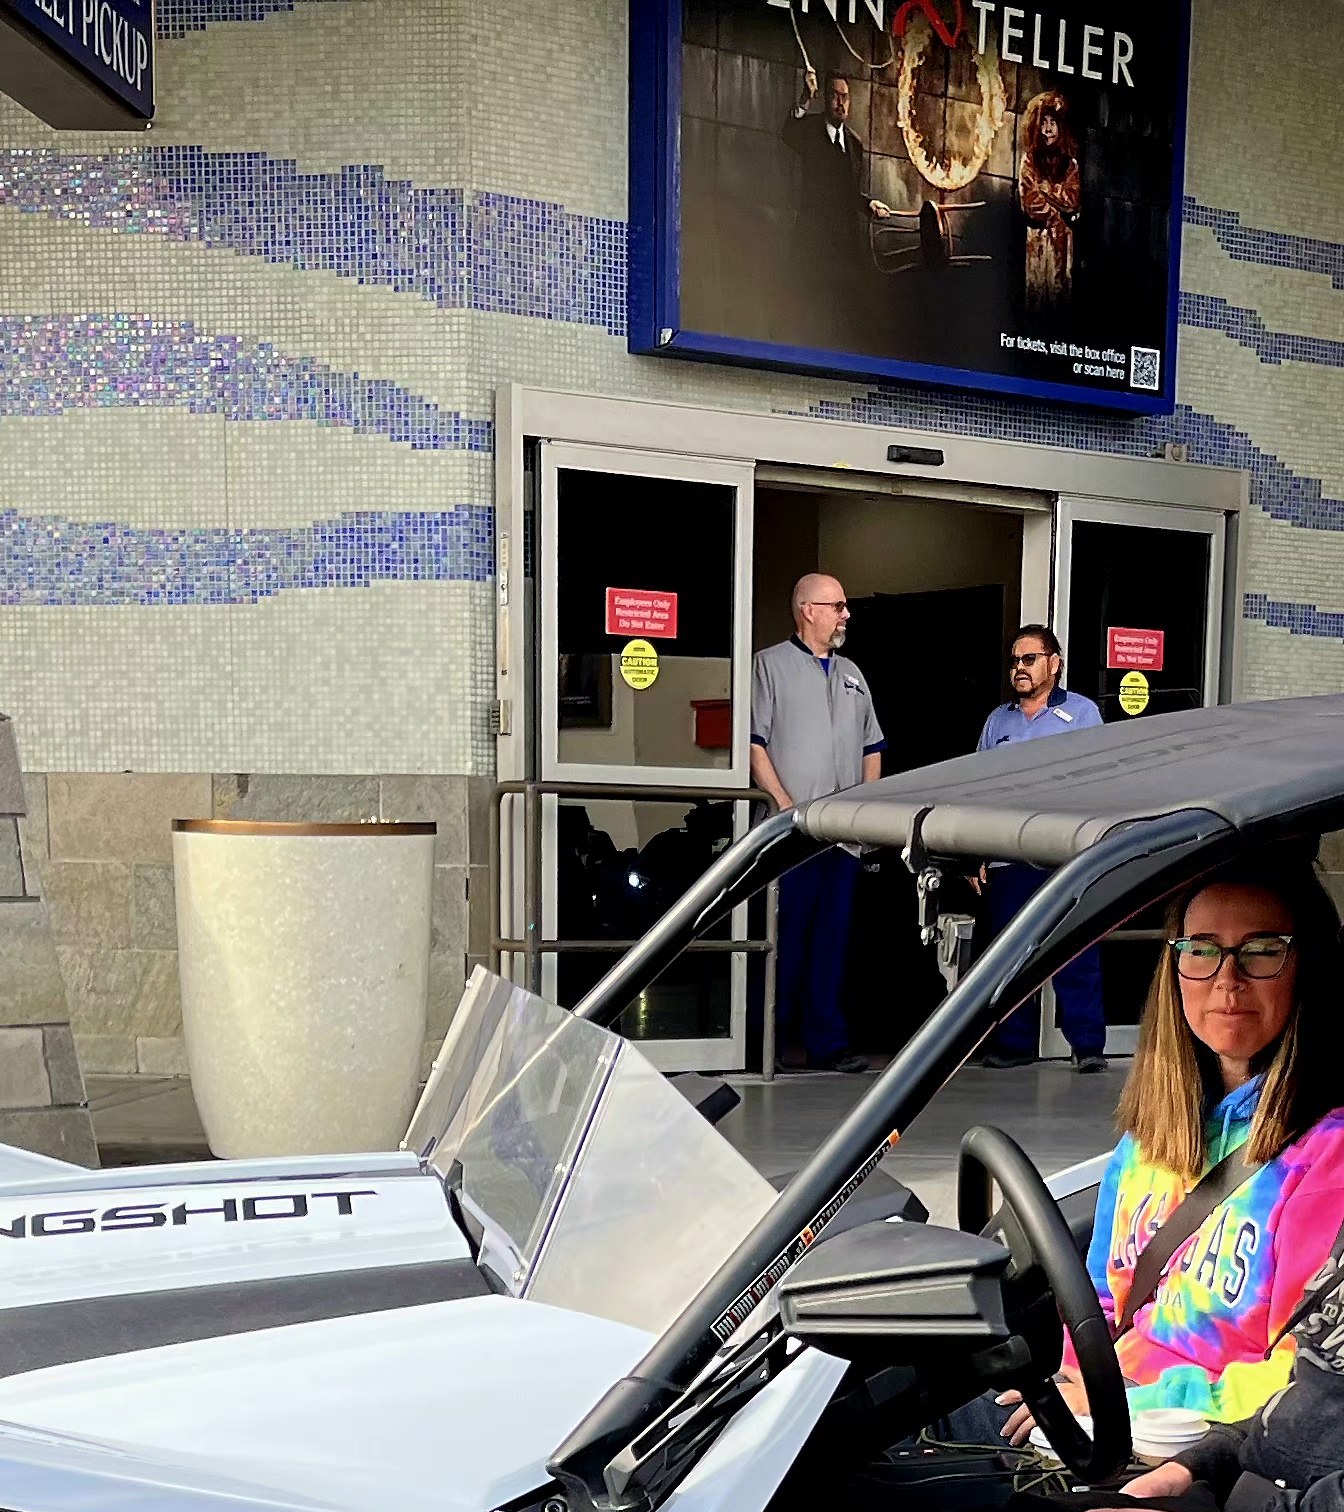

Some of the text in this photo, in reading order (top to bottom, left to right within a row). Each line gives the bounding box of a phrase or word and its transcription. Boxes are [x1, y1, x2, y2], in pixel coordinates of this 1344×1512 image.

[82, 0, 148, 92] PICKUP
[972, 0, 1135, 88] TELLER
[1000, 333, 1126, 364] For tickets, visit the box office
[1072, 362, 1125, 380] or scan here
[621, 656, 658, 667] CAUTION
